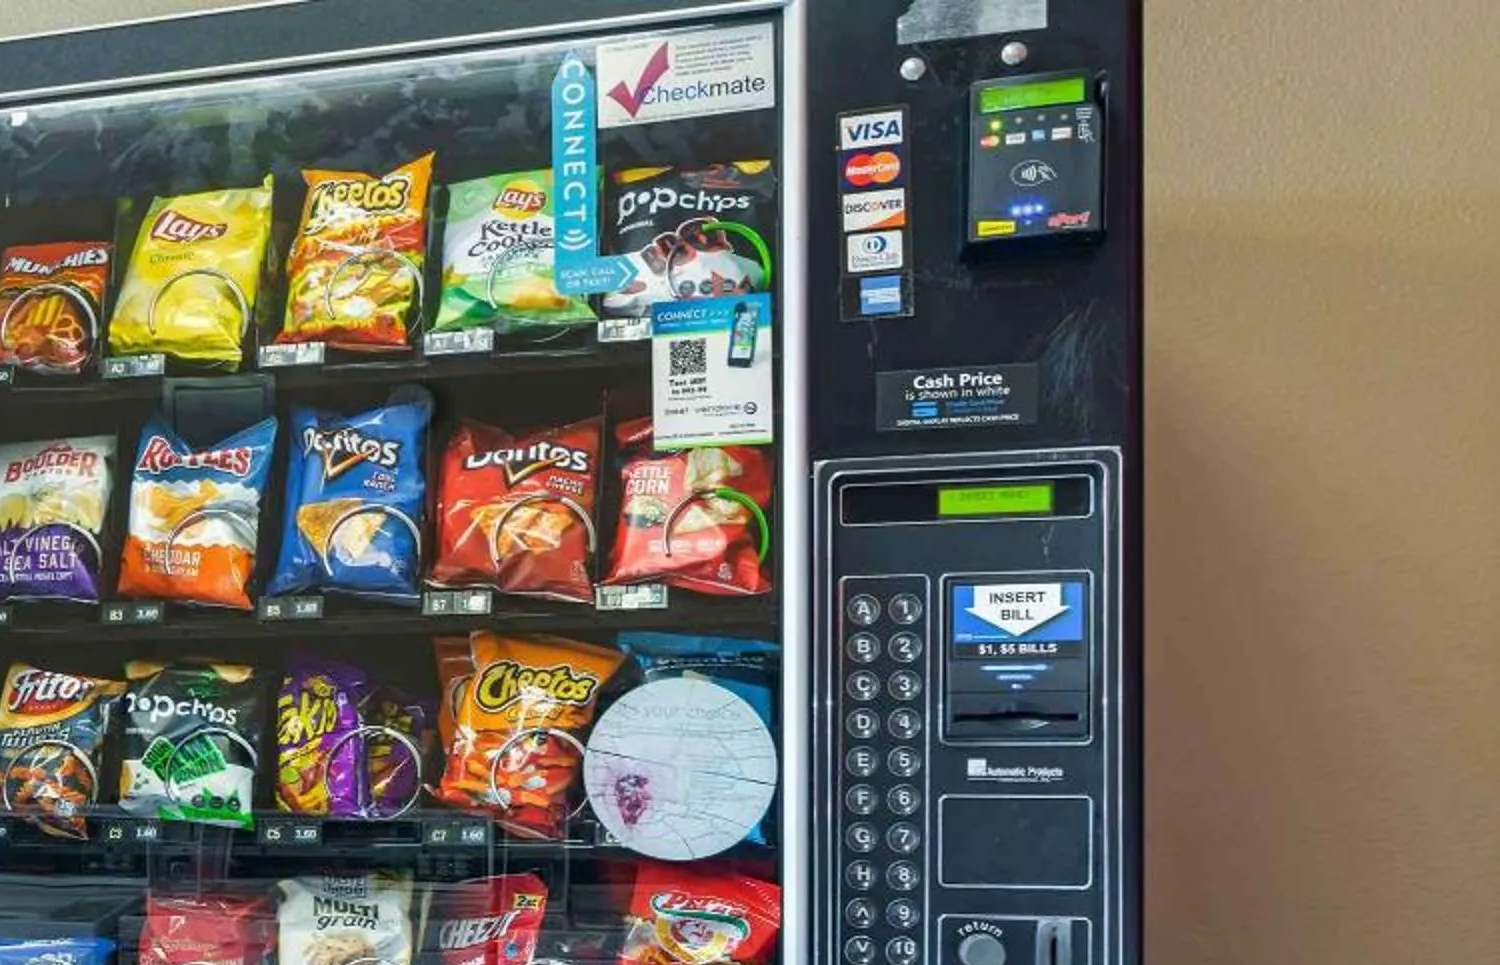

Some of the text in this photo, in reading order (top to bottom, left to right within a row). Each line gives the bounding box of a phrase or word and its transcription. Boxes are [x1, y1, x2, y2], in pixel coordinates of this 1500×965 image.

[643, 76, 765, 105] Checkmate
[848, 120, 900, 141] VISA
[562, 59, 586, 221] CONNECT
[846, 199, 902, 214] DISCOVER
[657, 308, 707, 323] CONNECT
[913, 372, 1003, 389] Cash Price
[905, 386, 1011, 400] is shown in white
[5, 446, 99, 484] BOULDER
[38, 550, 78, 570] SALT
[988, 590, 1046, 605] INSERT
[857, 601, 870, 616] A
[902, 601, 909, 614] 1
[1000, 609, 1034, 622] BILL
[857, 640, 869, 653] B
[900, 640, 911, 653] 2
[1019, 642, 1058, 654] BILLS
[478, 661, 596, 712] Cheetos
[857, 677, 869, 691] C
[900, 677, 910, 691] 3
[857, 715, 869, 729] D
[899, 715, 910, 729] 4
[857, 753, 869, 767] E
[900, 753, 910, 767] 5
[857, 791, 868, 805] F
[900, 792, 910, 805] 6
[855, 829, 870, 844] G
[900, 829, 910, 843] 7
[857, 867, 870, 881] H
[899, 867, 910, 881] 8
[314, 896, 379, 919] MULTI
[899, 905, 910, 921] 9
[316, 914, 378, 931] grain
[957, 919, 1003, 937] return
[895, 941, 915, 955] 10
